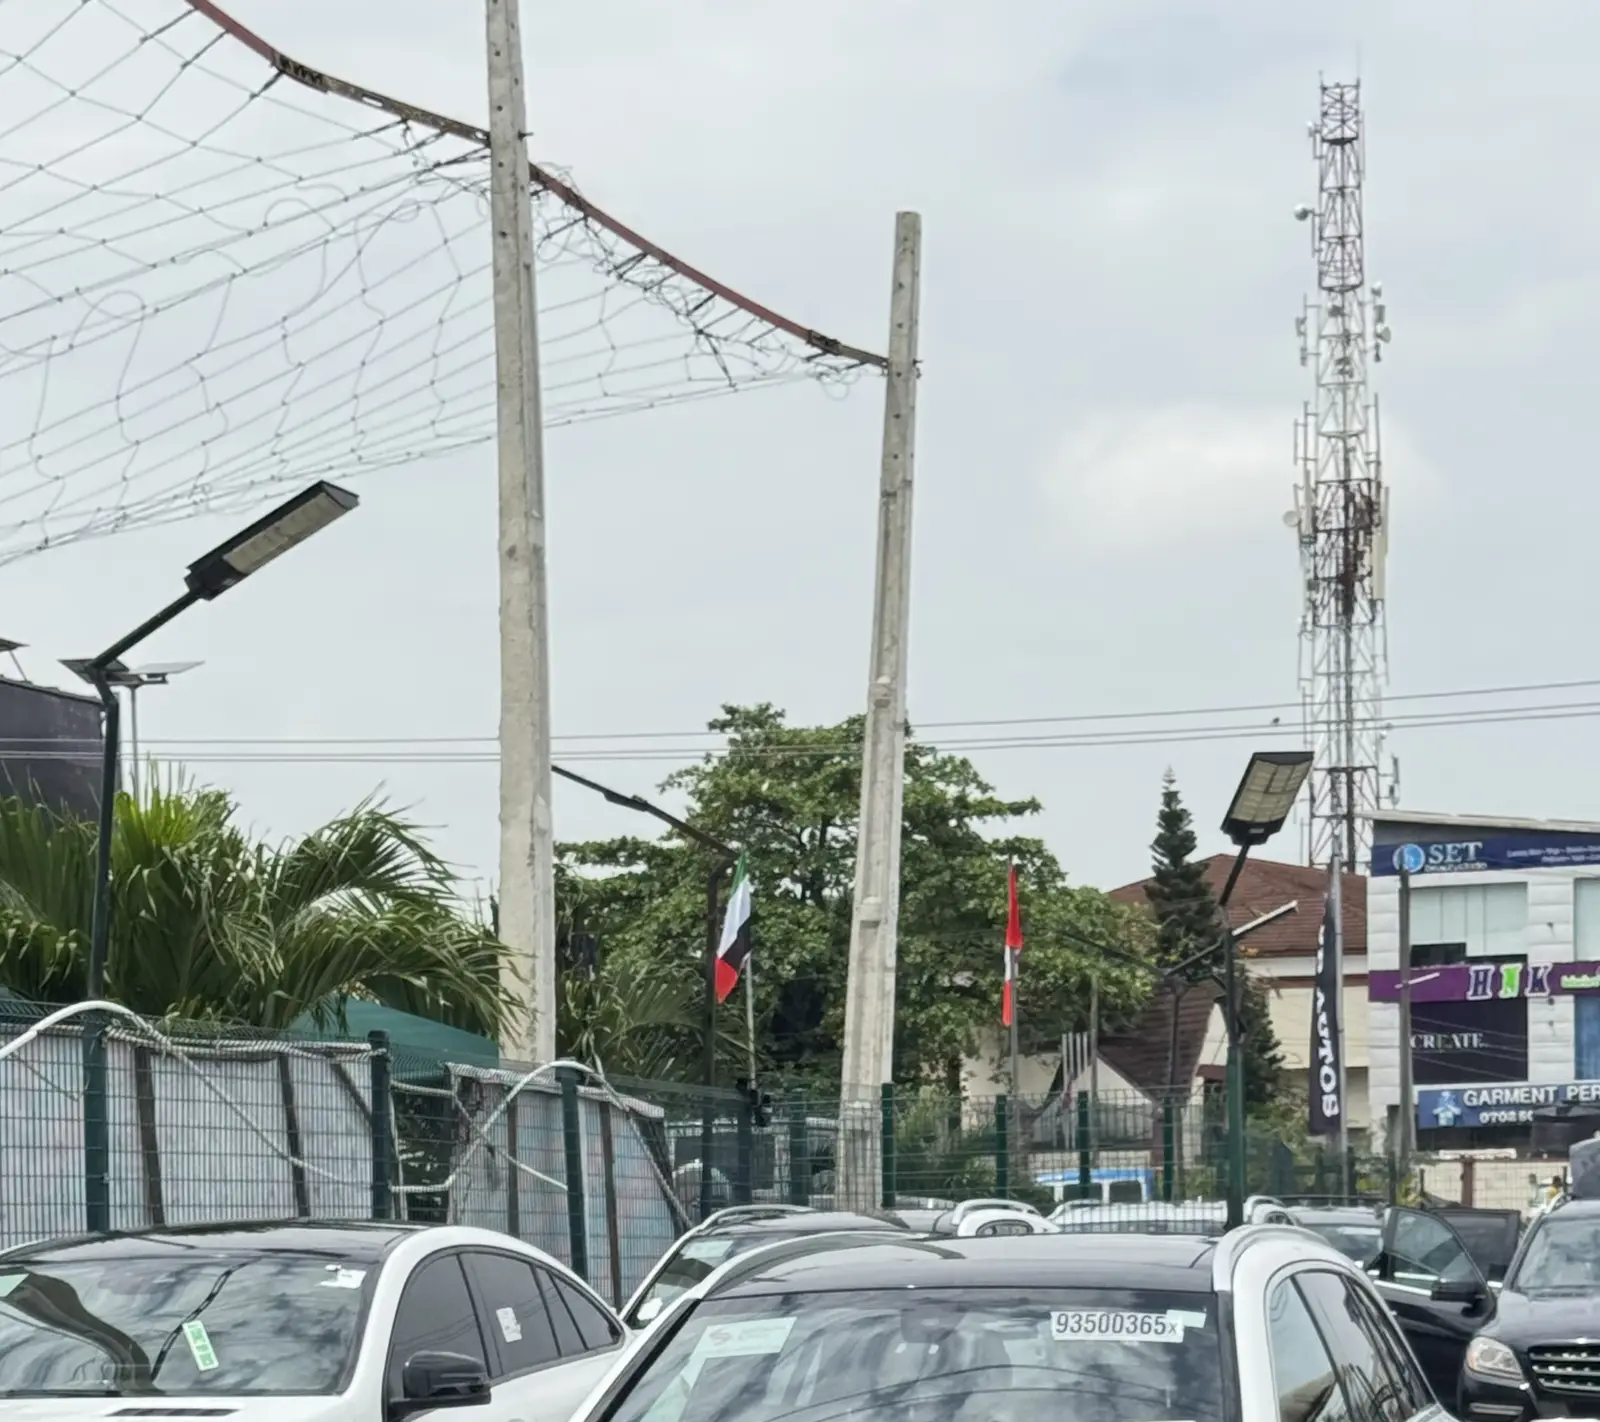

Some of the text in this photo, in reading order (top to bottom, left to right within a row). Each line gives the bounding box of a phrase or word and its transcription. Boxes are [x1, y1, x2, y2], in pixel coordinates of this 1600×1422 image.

[1428, 841, 1484, 864] SET
[1315, 987, 1340, 1118] AUTOS
[1463, 1087, 1558, 1107] GARMENT
